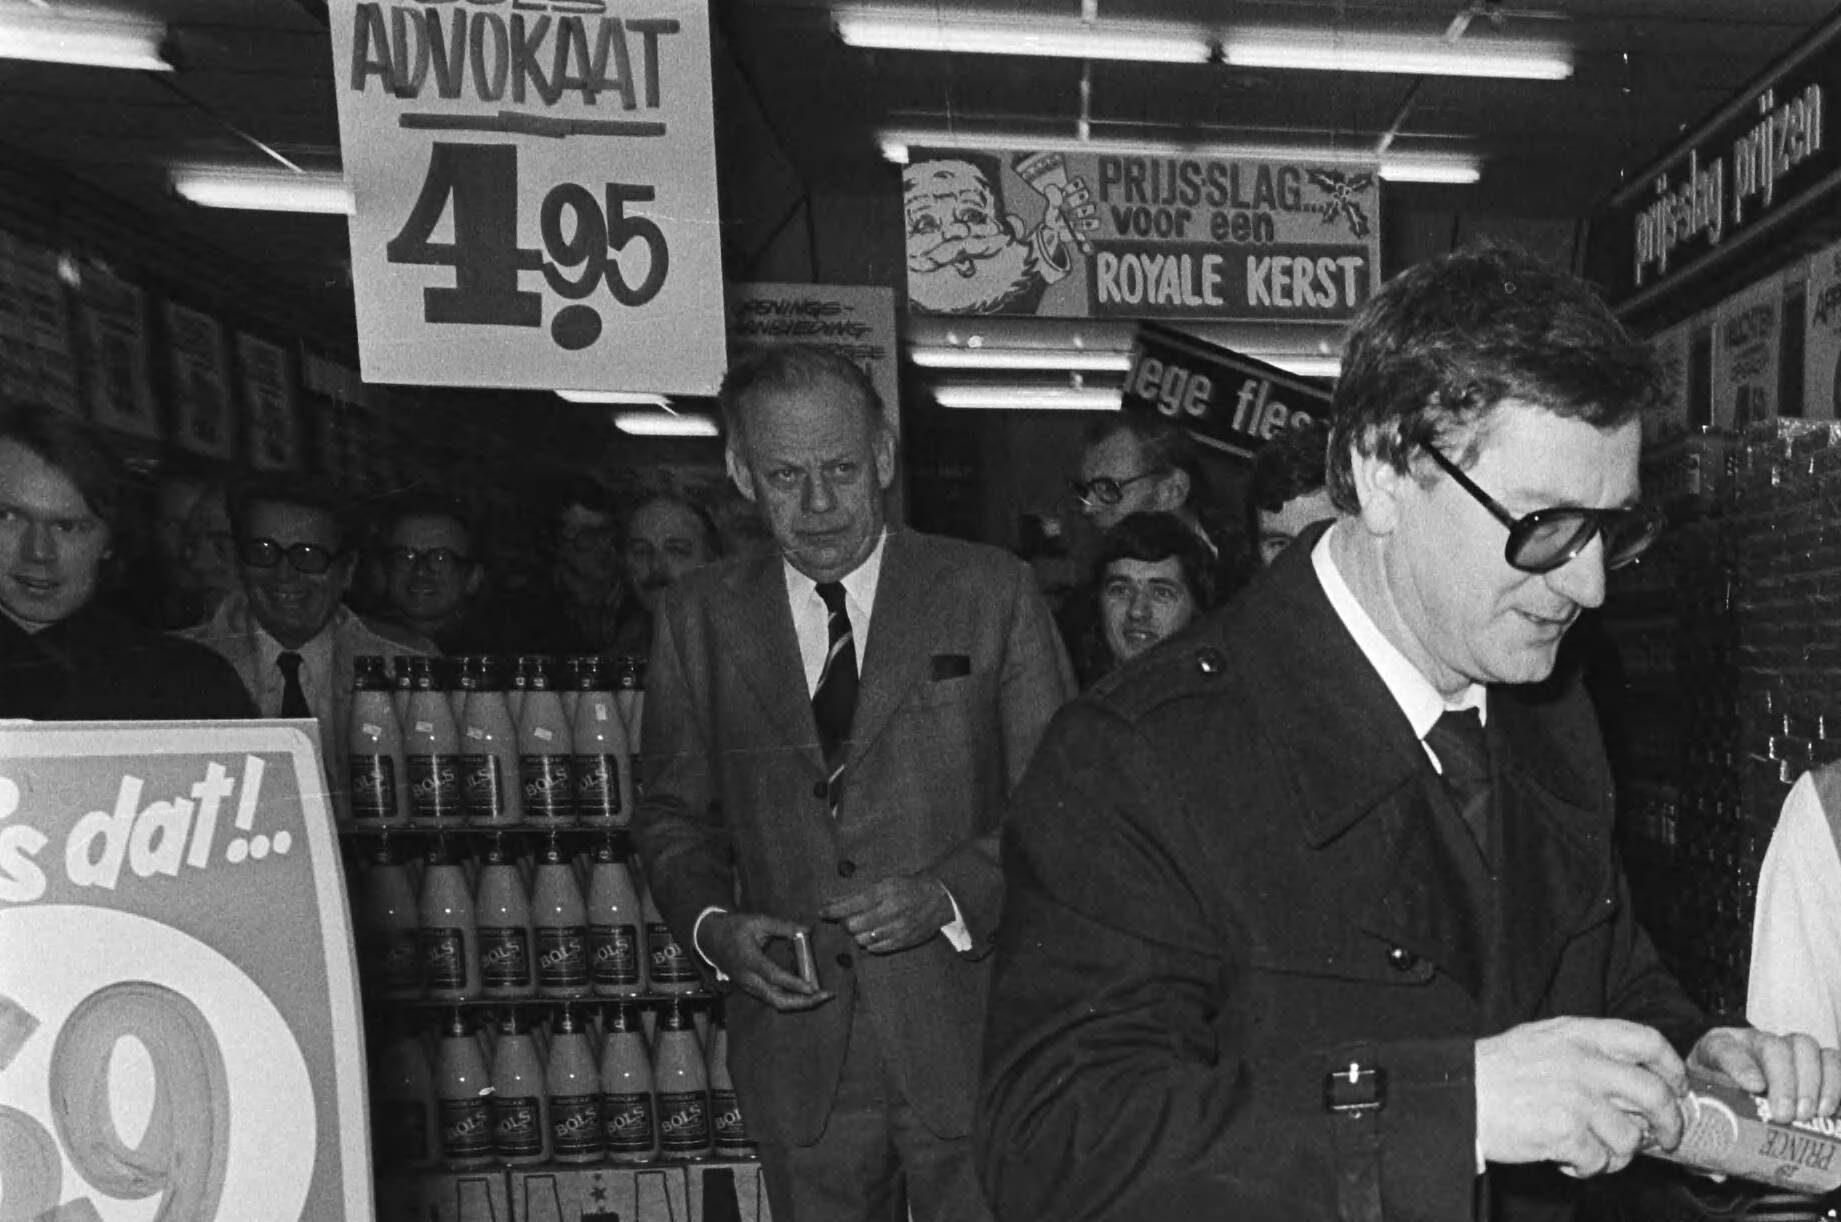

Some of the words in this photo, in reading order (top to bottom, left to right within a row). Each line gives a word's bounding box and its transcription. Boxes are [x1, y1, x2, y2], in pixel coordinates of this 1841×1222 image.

[350, 3, 681, 111] ADVOKAAT
[1111, 206, 1192, 241] voor
[1209, 211, 1275, 244] een
[1098, 254, 1223, 306] ROYALE
[1248, 256, 1363, 307] KERST
[526, 767, 569, 798] BOLS
[539, 940, 582, 969] BOLS
[554, 1106, 597, 1138] BOLS
[606, 1104, 646, 1135] BOLS
[661, 1104, 703, 1135] BOLS
[1758, 1127, 1837, 1172] PRINCE
